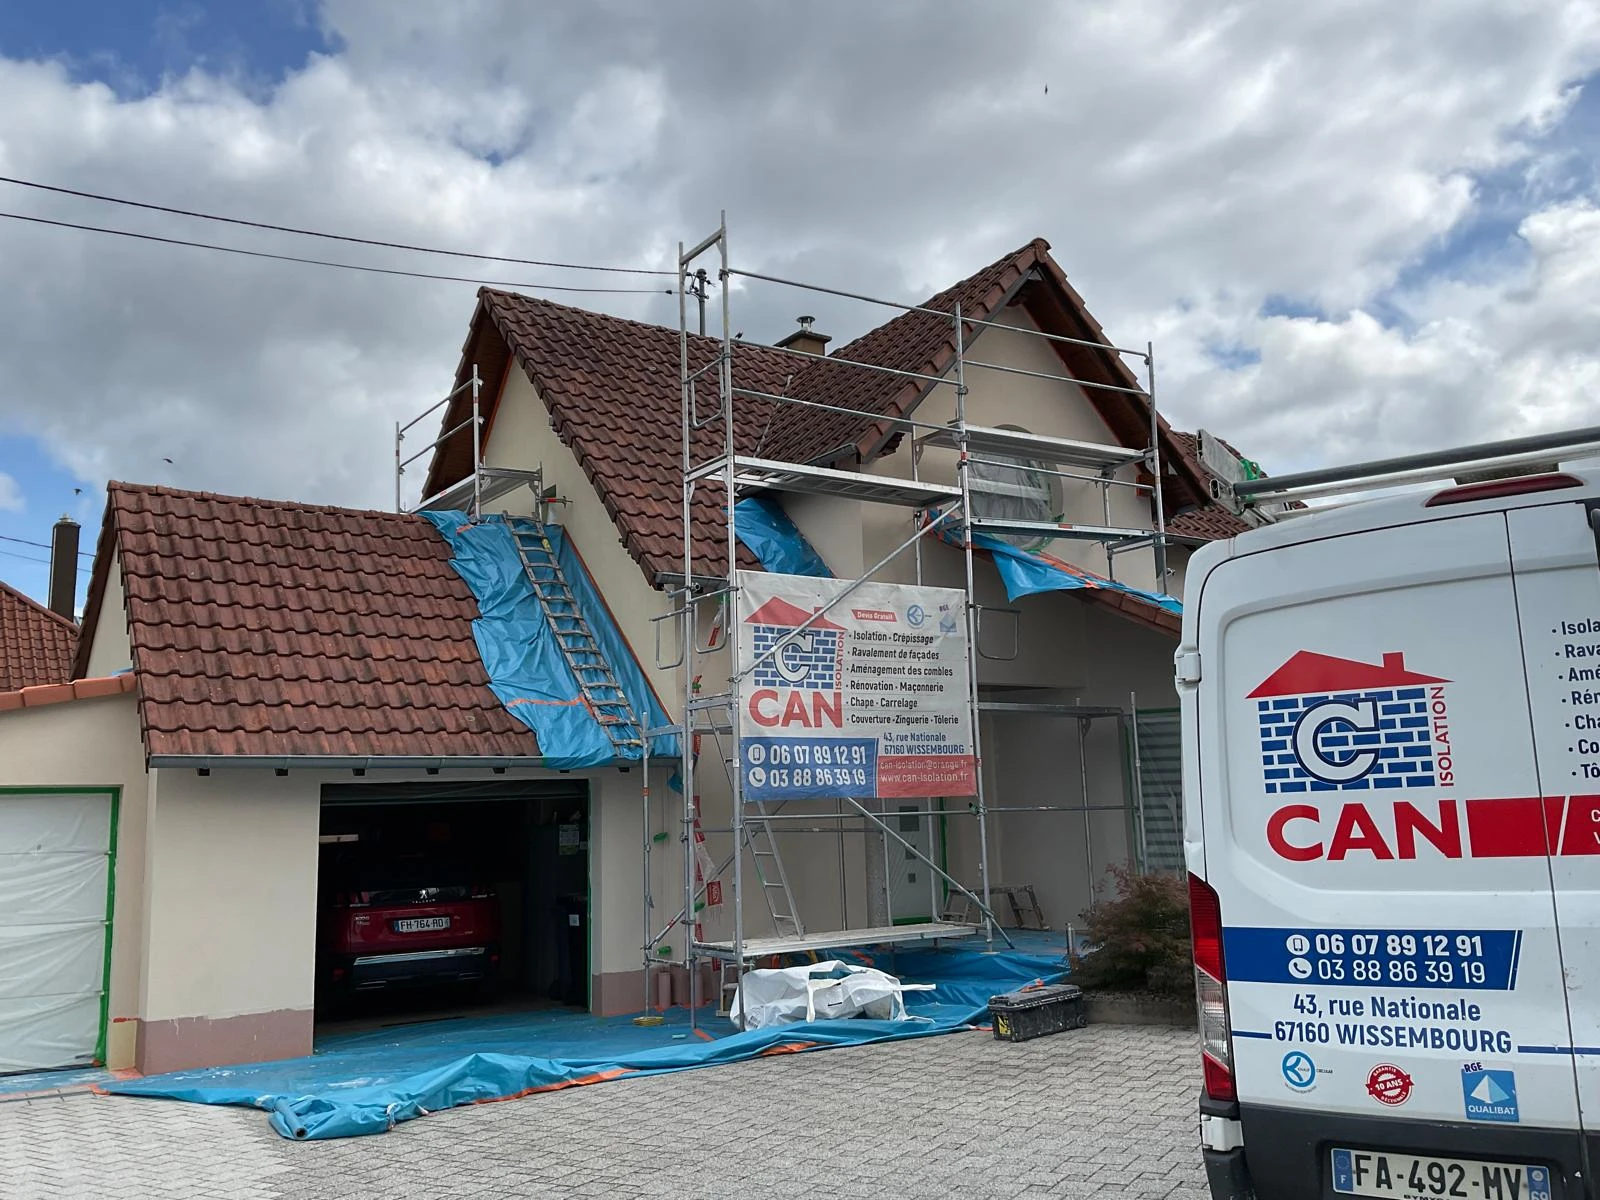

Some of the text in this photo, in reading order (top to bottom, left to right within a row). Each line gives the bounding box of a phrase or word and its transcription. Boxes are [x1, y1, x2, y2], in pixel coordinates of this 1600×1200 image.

[857, 611, 893, 620] Devis Gratuit
[853, 630, 934, 646] Isolation Crépissage
[835, 631, 845, 691] ISOLATION
[852, 646, 939, 661] Ravalement de façades
[850, 663, 953, 676] Aménagement des combles
[850, 679, 944, 693] Rénovation Maçonnerie
[748, 689, 843, 728] CAN
[850, 697, 918, 709] Chape Carrelage
[851, 714, 959, 725] Couverture Zinguerie Tôlerie
[883, 732, 947, 743] 43, rue Nationale
[1430, 686, 1455, 788] ISOLATION
[770, 744, 866, 765] 06 07 89 12 91
[884, 744, 965, 755] 67160 WISSEMBOURG
[770, 768, 866, 787] 03 88 86 39 19
[880, 771, 969, 782] www.can-isolation.fr
[1266, 799, 1463, 862] CAN
[1315, 934, 1483, 957] 06 07 89 12 91
[1318, 958, 1486, 984] 03 88 86 39 19
[1293, 994, 1481, 1021] 43, rue Nationale
[1274, 1020, 1512, 1053] 67160 WISSEMBOURG
[1463, 1061, 1483, 1073] RGE
[1375, 1078, 1403, 1091] 10 ANS
[1468, 1104, 1516, 1115] QUALIBAT
[1340, 1174, 1347, 1184] F
[1354, 1154, 1522, 1200] FA-492-MV
